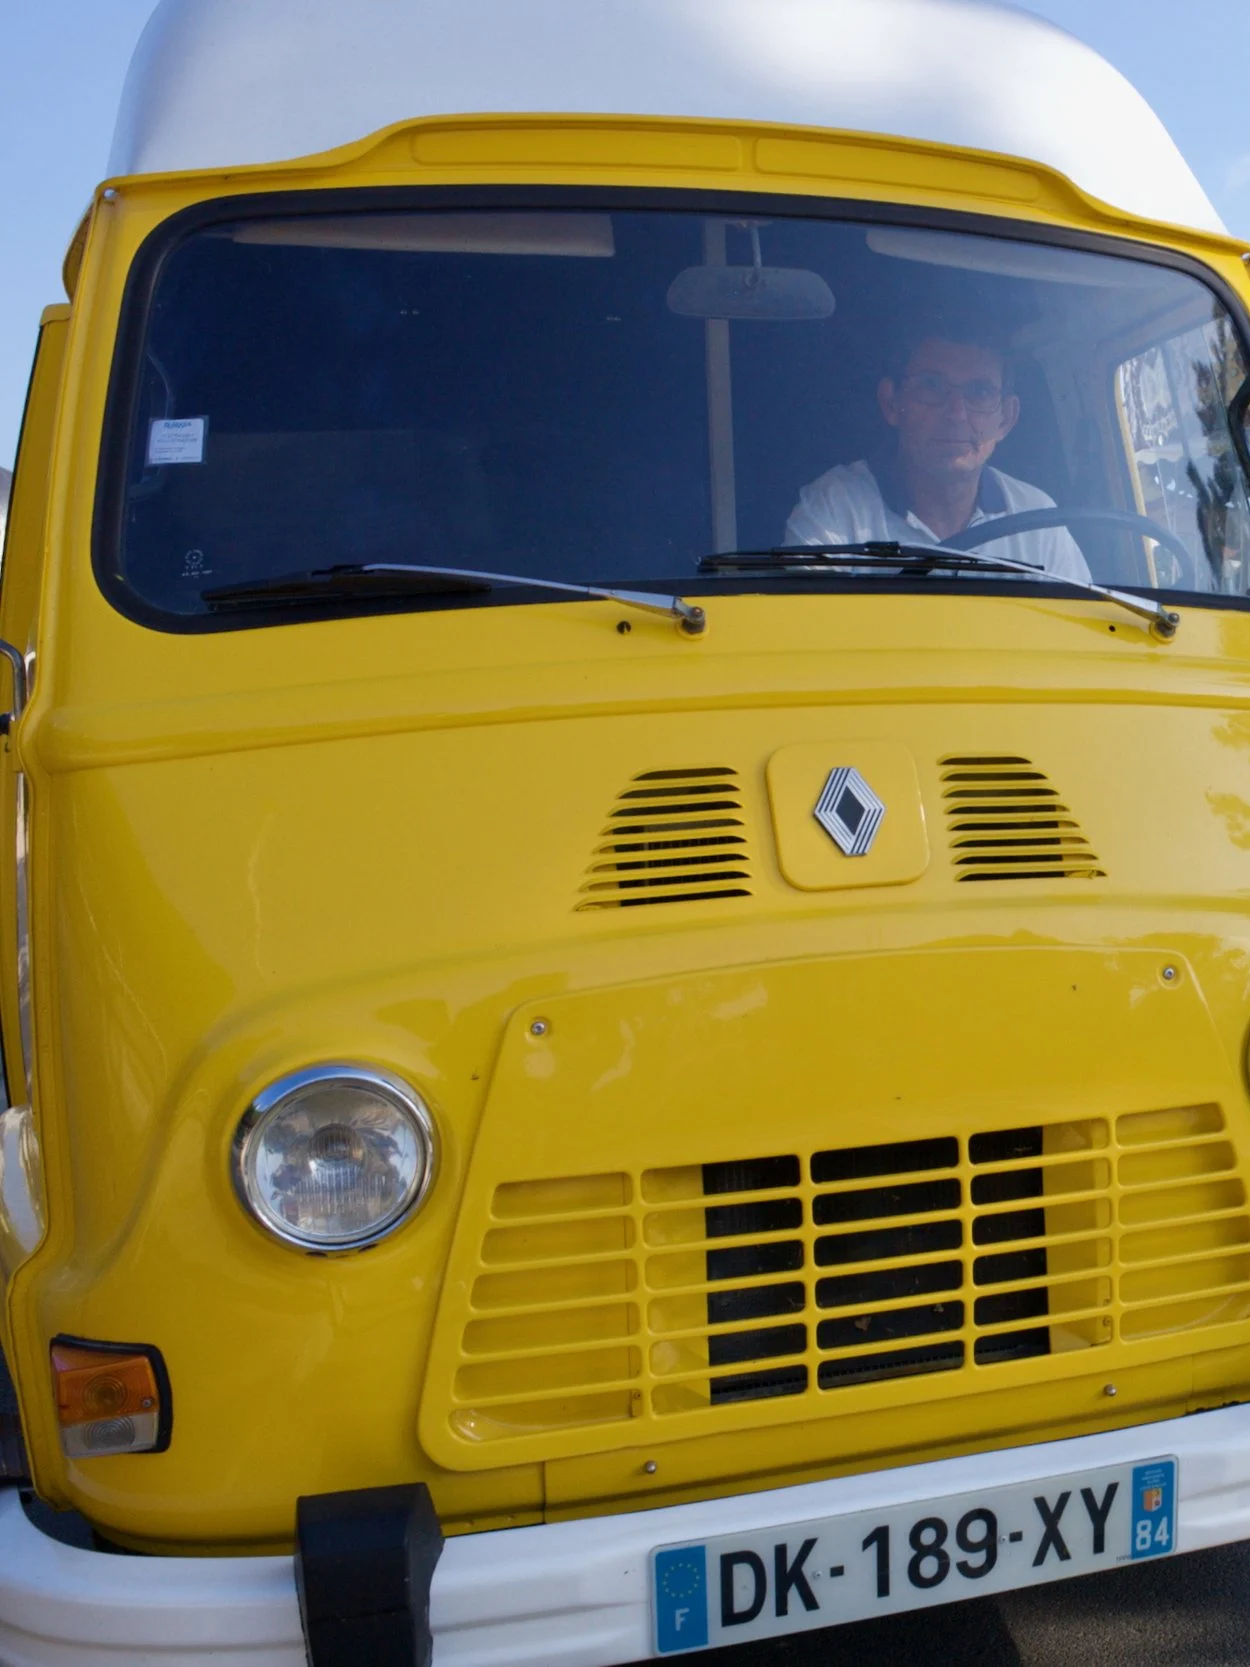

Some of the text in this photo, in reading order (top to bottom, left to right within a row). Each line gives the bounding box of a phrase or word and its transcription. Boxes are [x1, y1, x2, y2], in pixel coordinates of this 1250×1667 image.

[1135, 1516, 1170, 1551] 84
[720, 1482, 1120, 1628] DK-189-XY
[674, 1607, 690, 1631] F
